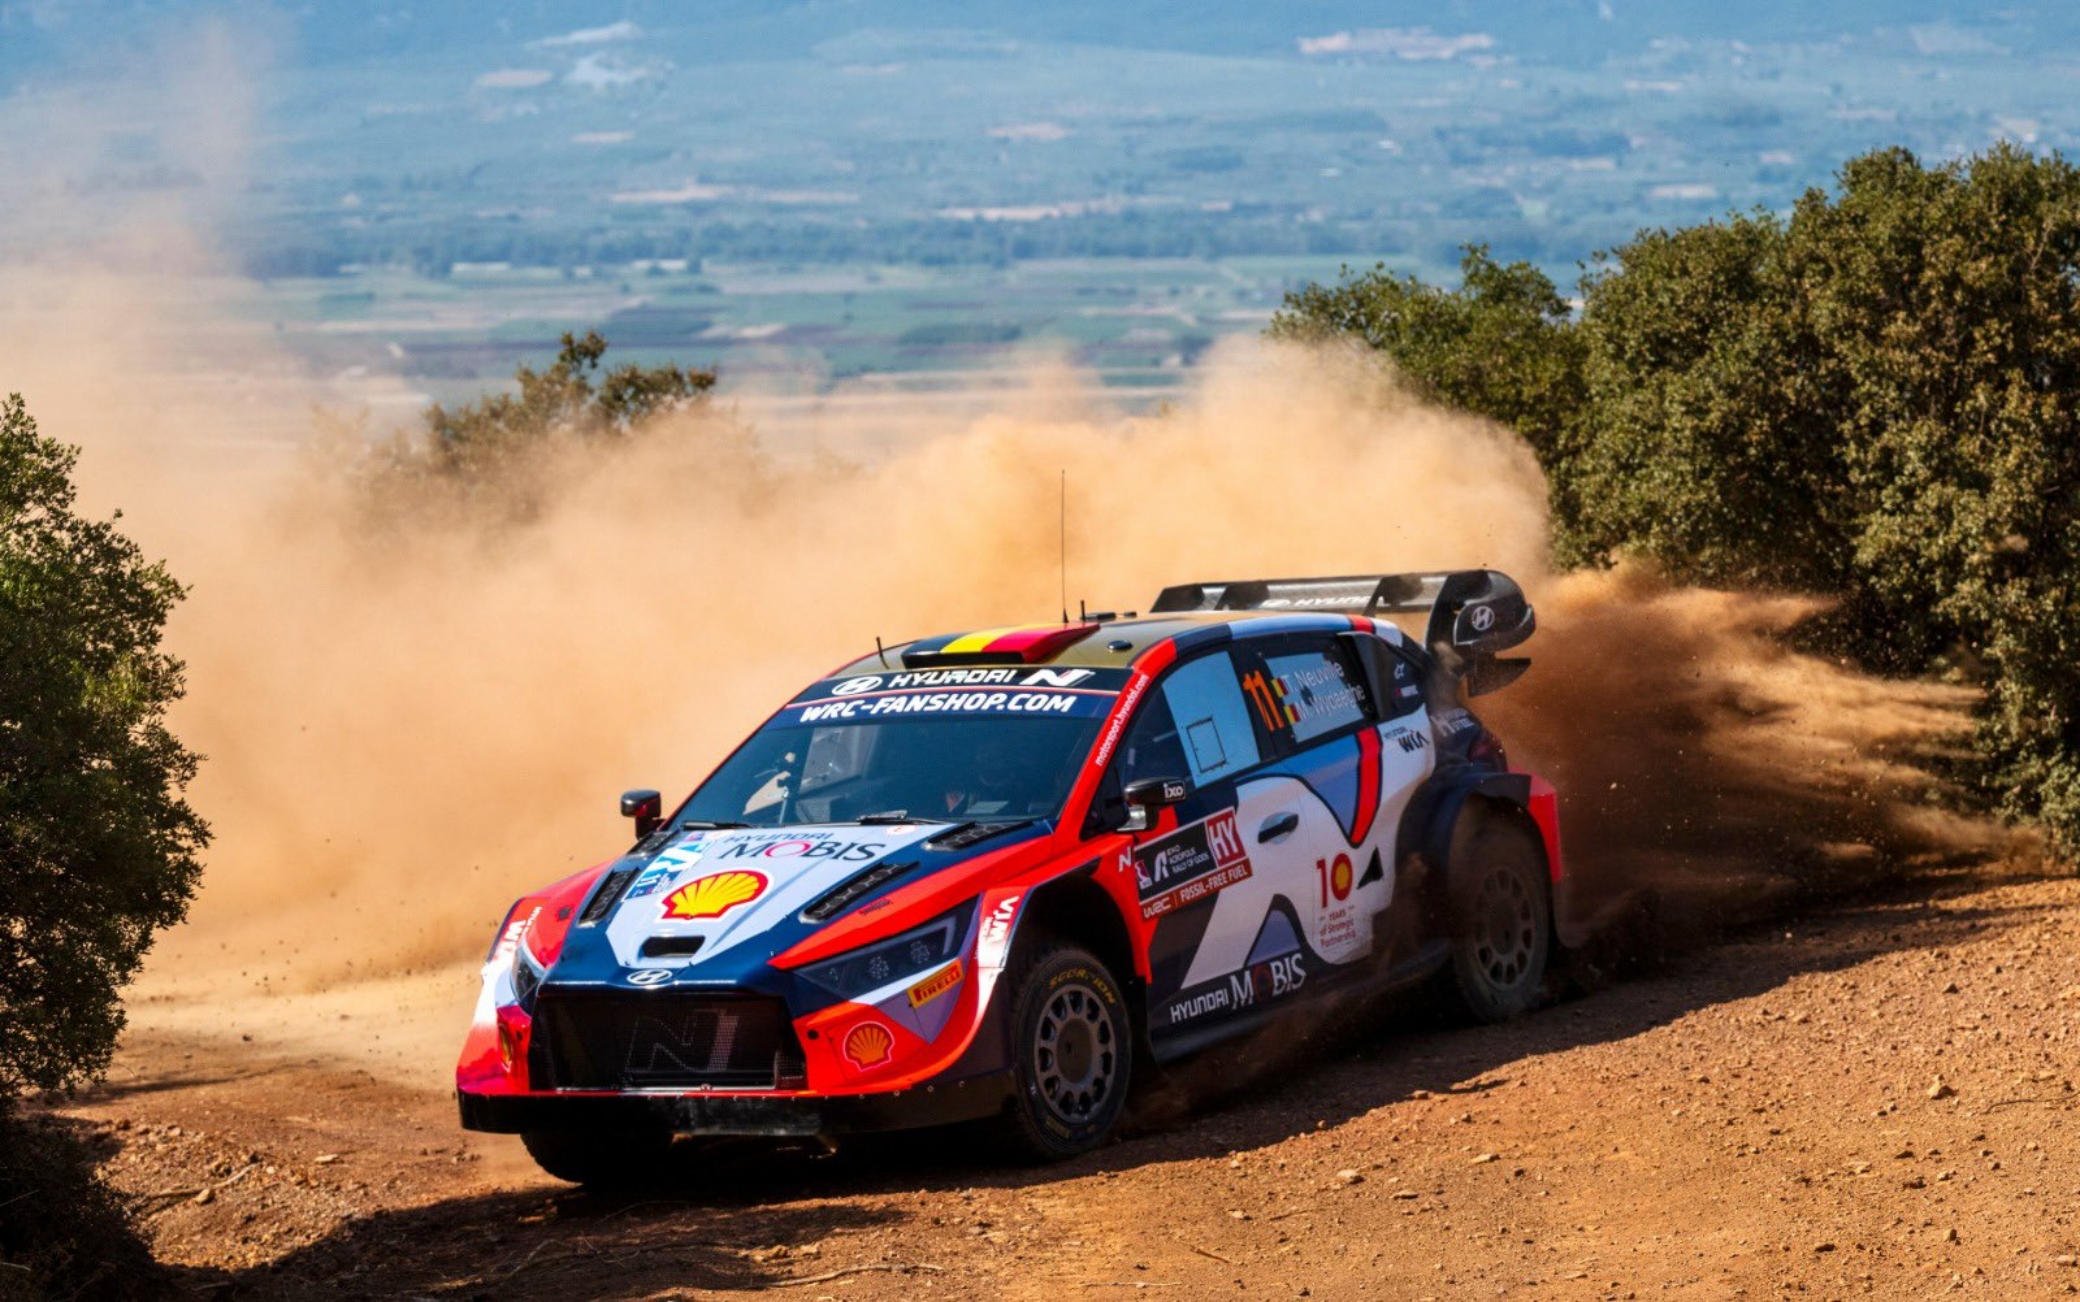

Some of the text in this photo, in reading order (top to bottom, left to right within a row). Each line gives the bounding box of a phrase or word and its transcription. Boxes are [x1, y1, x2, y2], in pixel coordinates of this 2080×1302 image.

[888, 669, 1017, 688] HYUNDAI
[800, 693, 1077, 723] WRC-FANSHOP.COM
[1242, 669, 1285, 732] 11
[1095, 674, 1149, 767] motorsport.hyundai.com
[1398, 730, 1429, 753] WIA
[718, 841, 887, 861] MOBIS
[724, 832, 835, 843] HYUNDAI
[1209, 817, 1238, 860] HY
[1180, 864, 1248, 903] FOSSIL-FREE FUEL
[1316, 853, 1353, 908] 10
[912, 964, 960, 1003] PIRELLI
[1230, 953, 1307, 1010] MOBIS
[1170, 988, 1229, 1023] HYUNDAI
